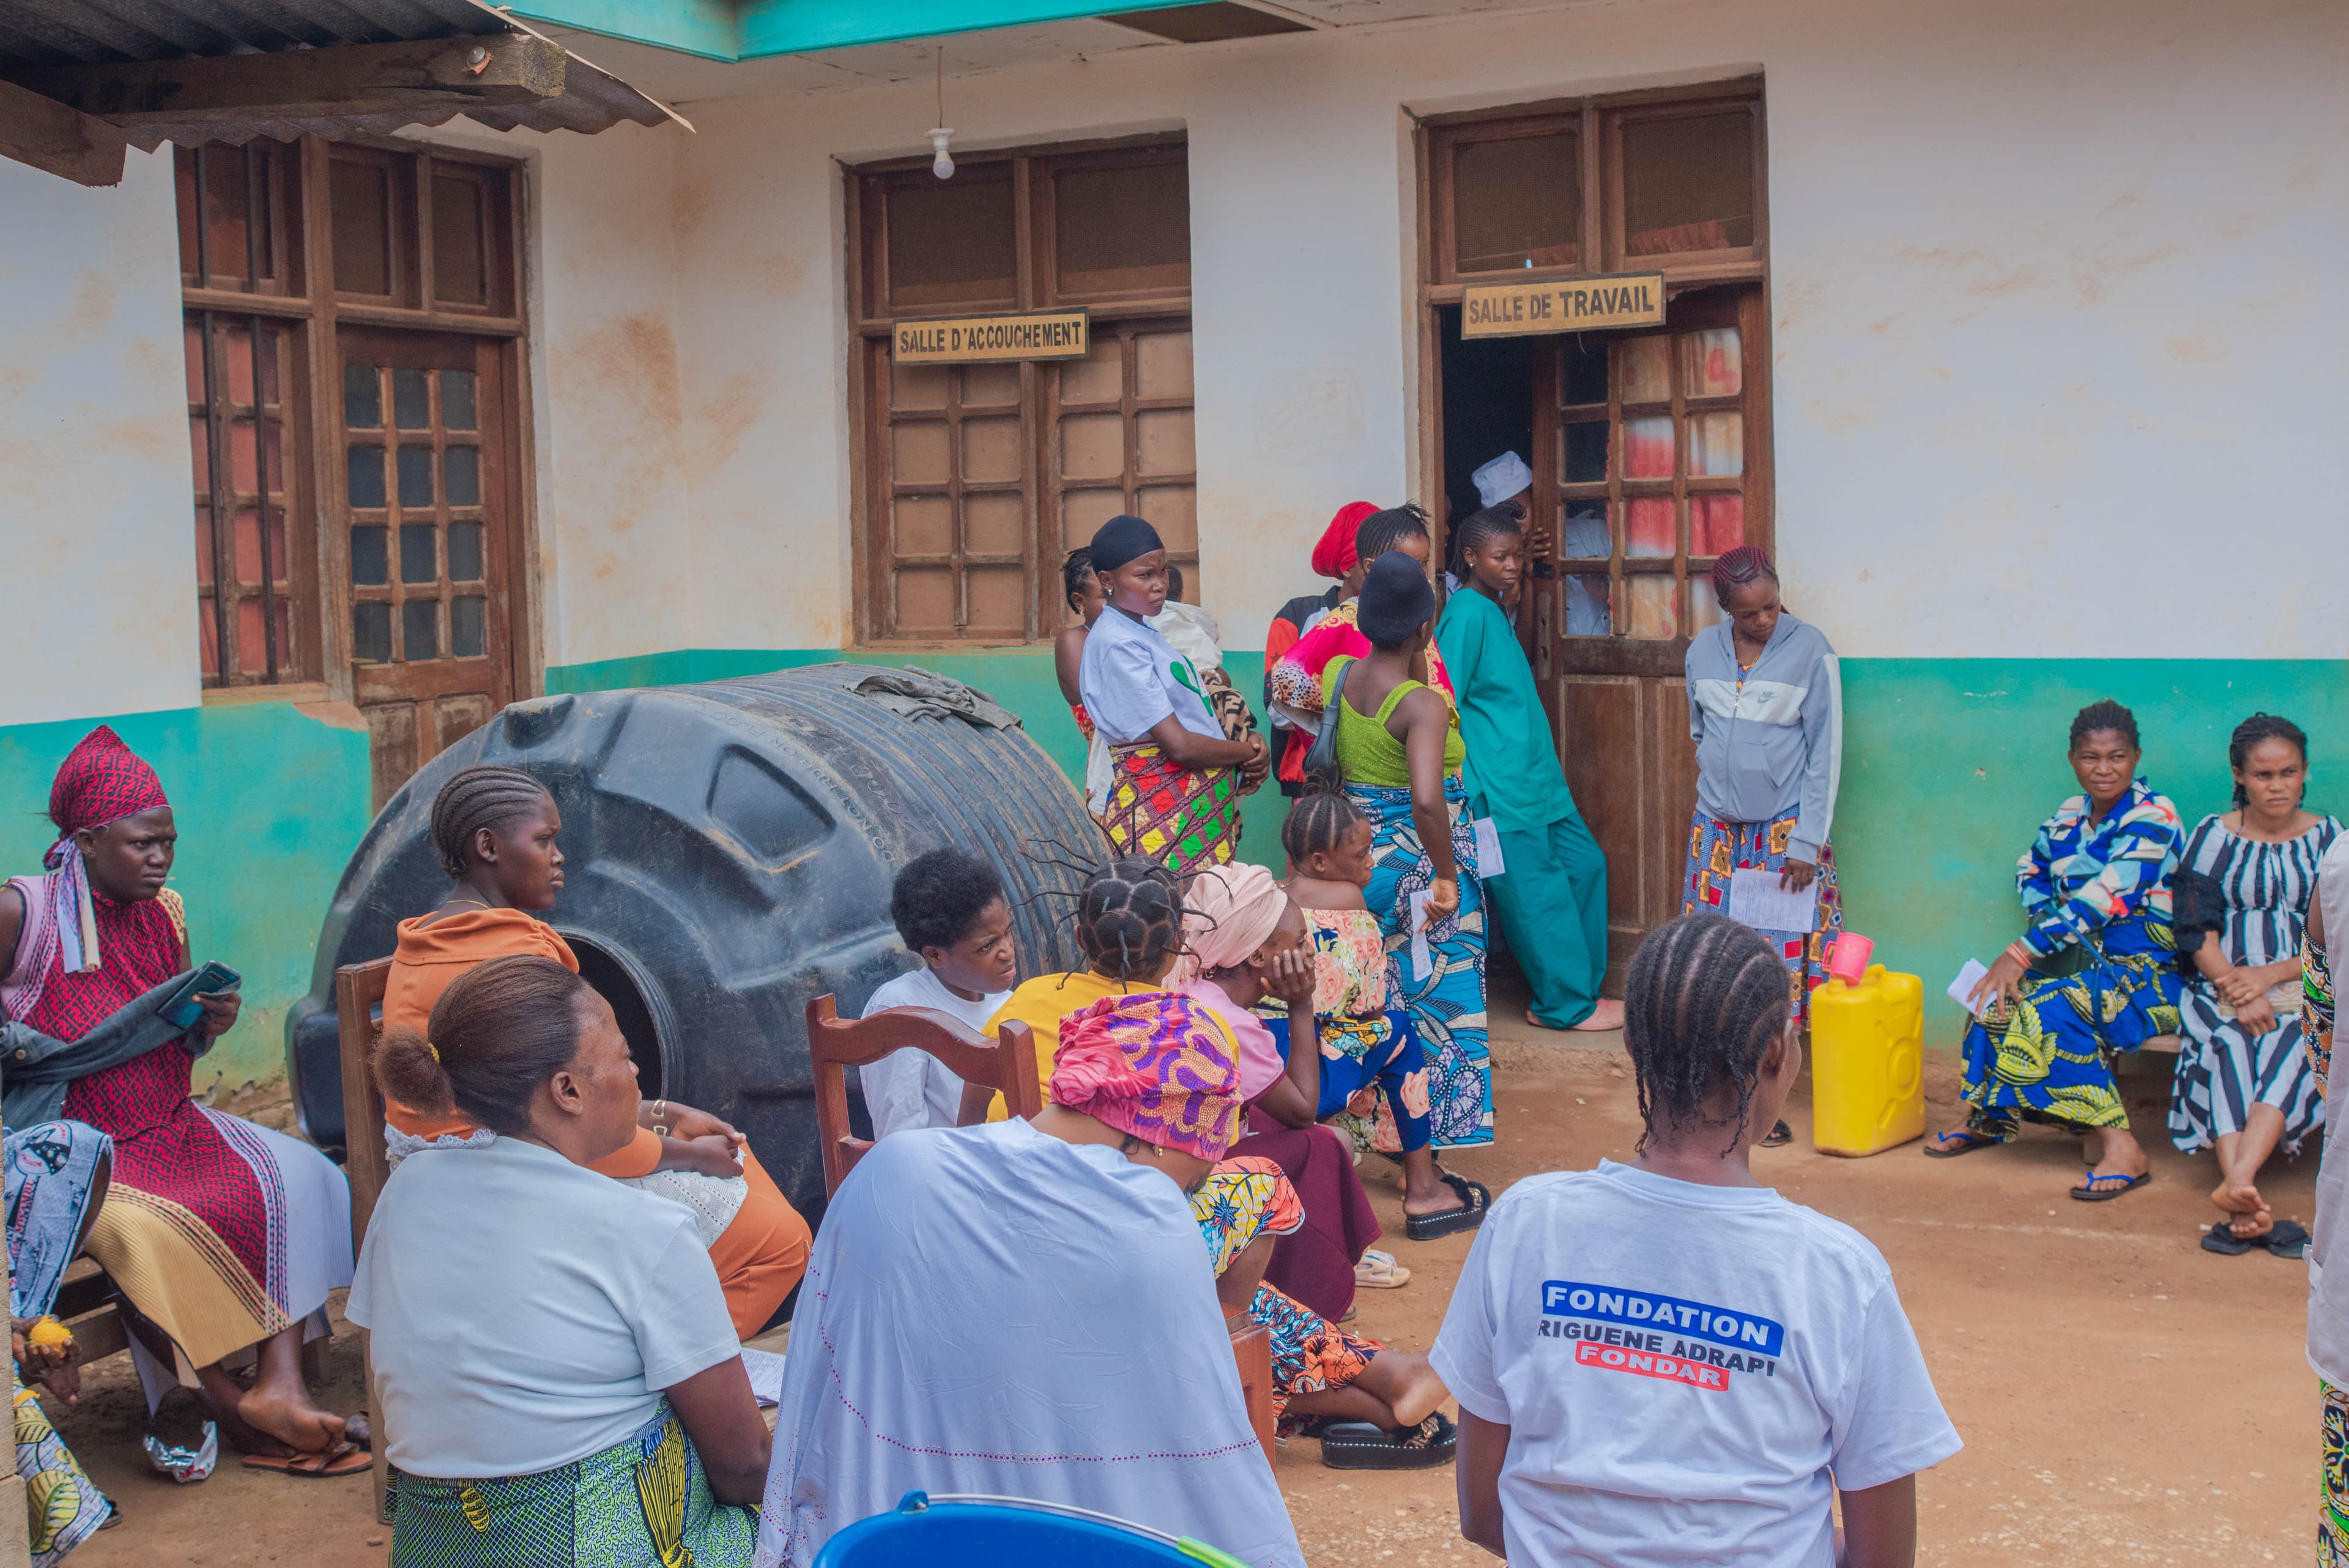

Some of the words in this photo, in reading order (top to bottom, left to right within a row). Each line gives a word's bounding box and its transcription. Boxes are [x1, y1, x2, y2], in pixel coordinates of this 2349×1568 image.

[1469, 296, 1523, 324] SALLE
[1530, 294, 1552, 319] DE
[1560, 286, 1655, 318] TRAVAIL
[900, 329, 945, 353] SALLE
[952, 321, 1081, 351] D'ACCOUCHEMENT
[1546, 1286, 1769, 1347] FONDATION
[1538, 1319, 1663, 1353] RIGUENE
[1671, 1340, 1775, 1377] ADRAPI
[1580, 1345, 1721, 1386] FONDAR
